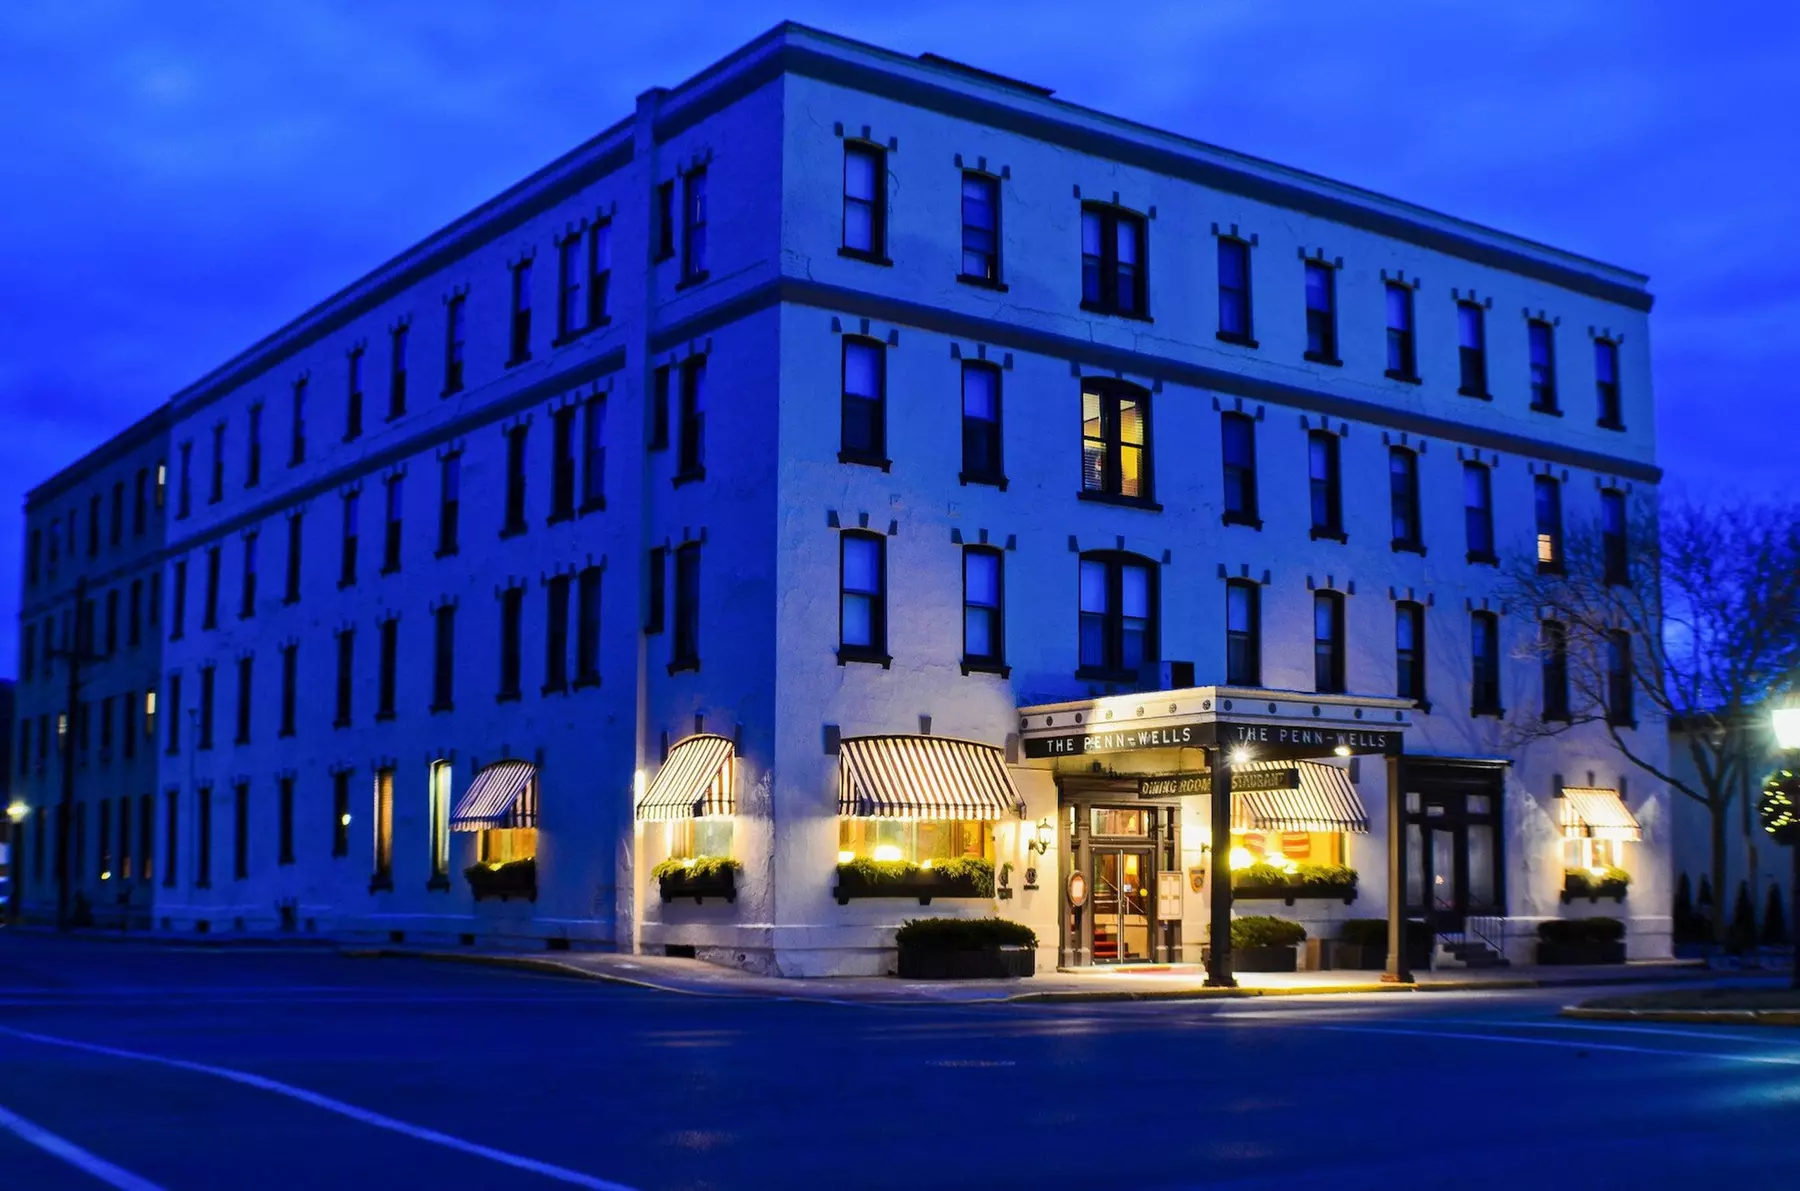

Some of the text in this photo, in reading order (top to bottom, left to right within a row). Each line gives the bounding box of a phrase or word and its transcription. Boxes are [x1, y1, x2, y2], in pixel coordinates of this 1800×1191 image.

[1047, 727, 1191, 753] THE PENN-WELLS
[1238, 727, 1385, 747] THE PENN-WELLS
[1142, 780, 1177, 795] DINING
